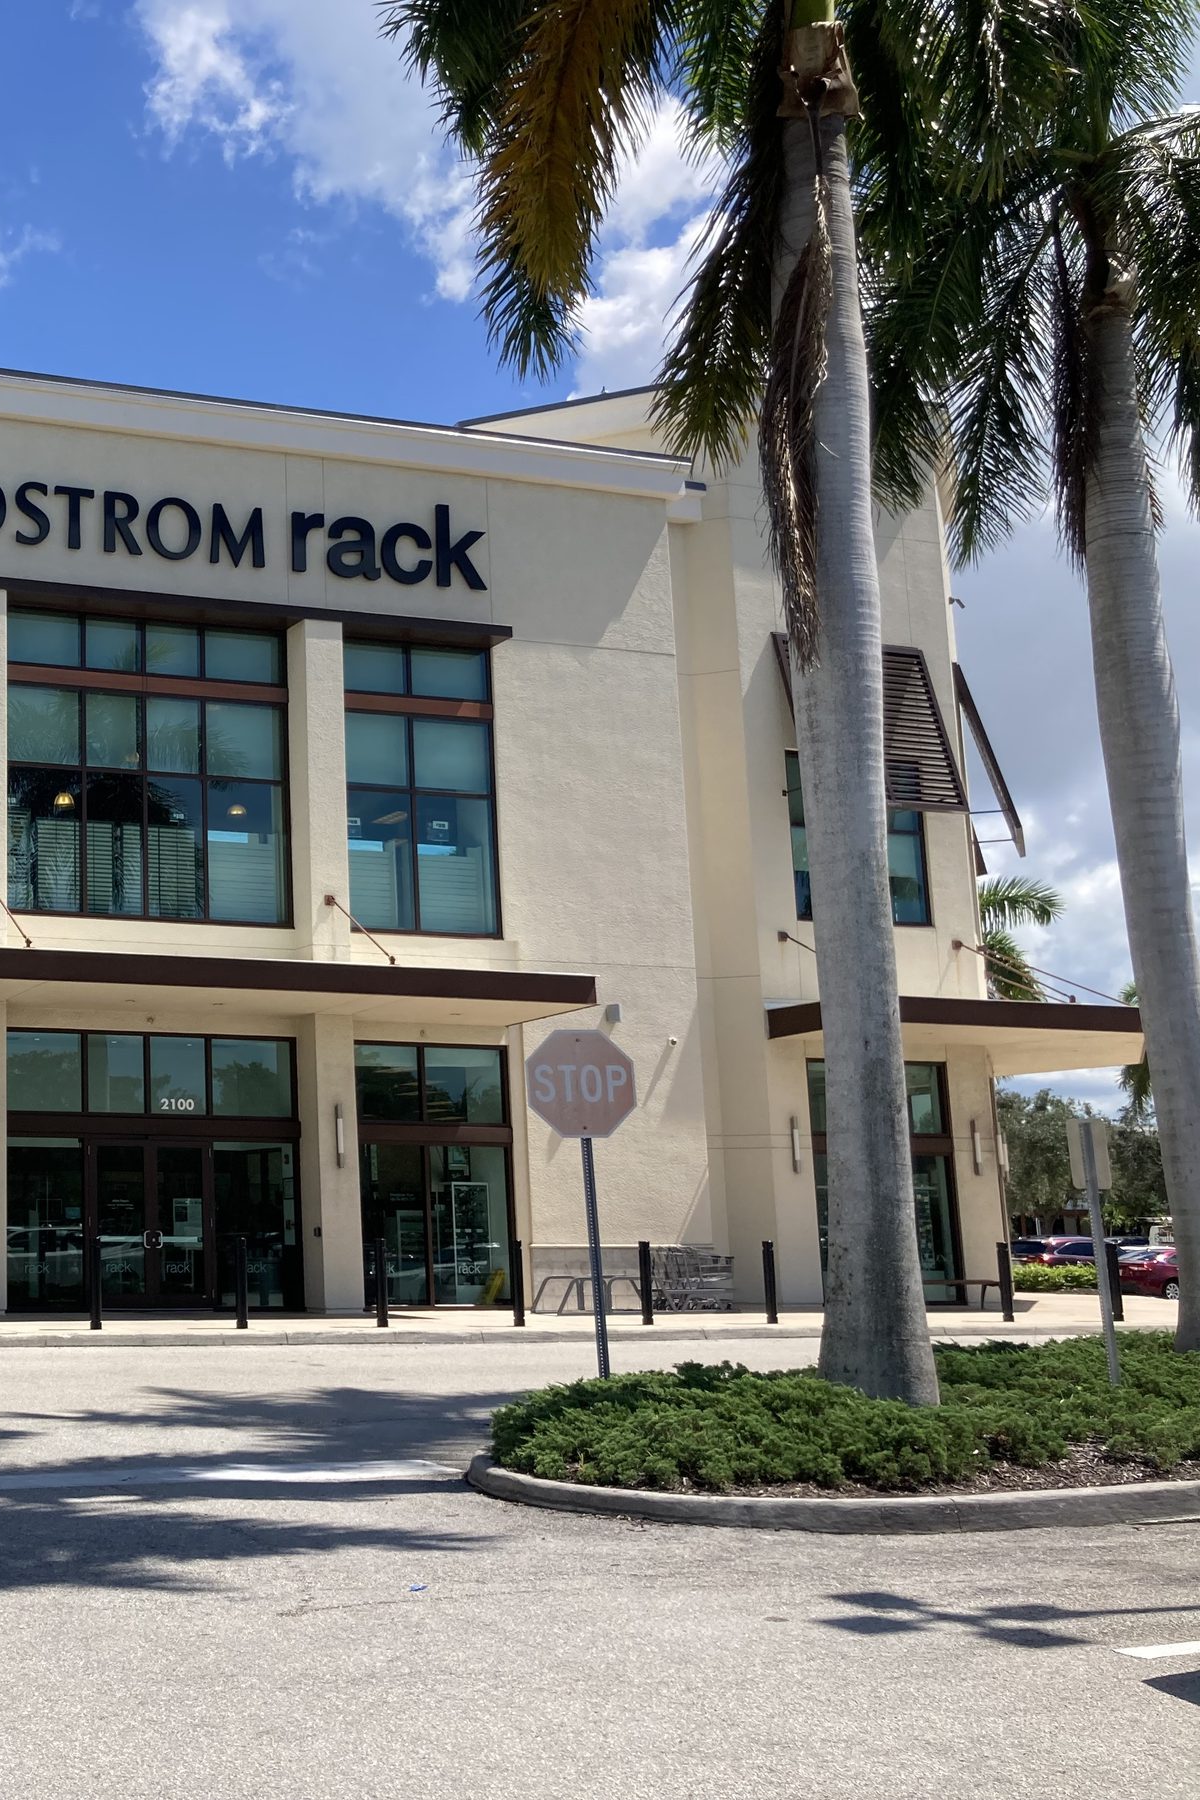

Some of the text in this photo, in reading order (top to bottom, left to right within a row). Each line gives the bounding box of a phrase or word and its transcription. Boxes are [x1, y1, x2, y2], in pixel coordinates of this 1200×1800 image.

[291, 504, 488, 591] rack
[534, 1064, 627, 1104] STOP
[160, 1098, 195, 1110] 2100
[24, 1261, 50, 1274] rack
[105, 1260, 132, 1273] rack
[166, 1260, 191, 1273] rack
[247, 1261, 268, 1273] ack
[458, 1262, 481, 1274] rack
